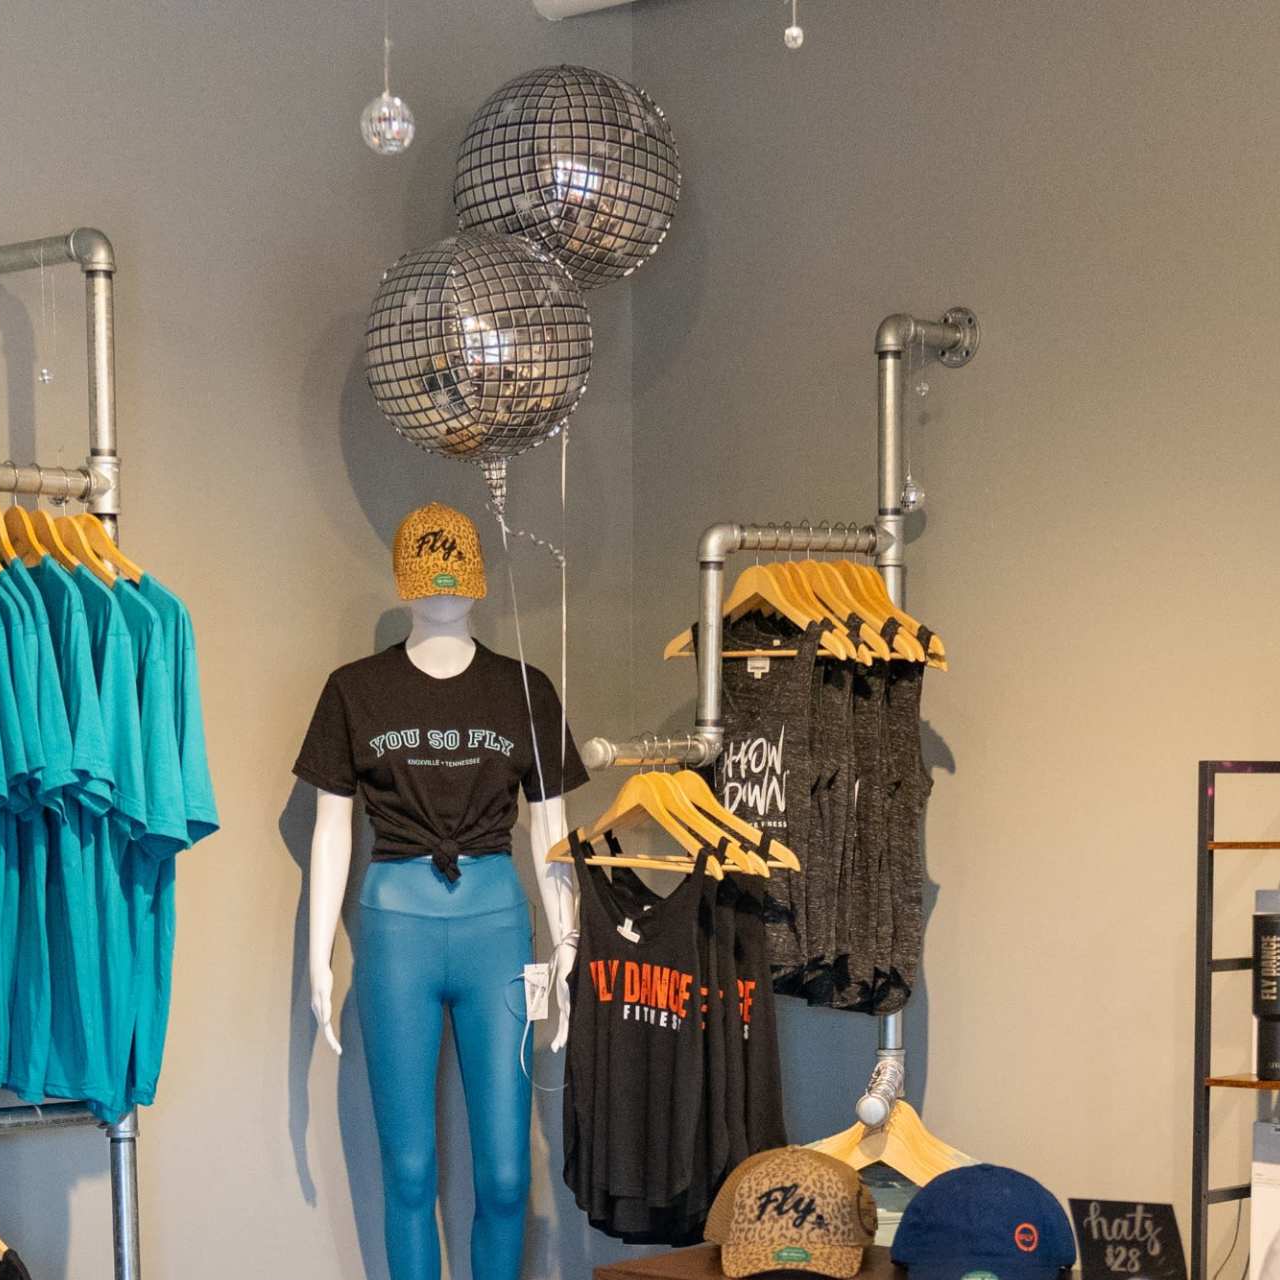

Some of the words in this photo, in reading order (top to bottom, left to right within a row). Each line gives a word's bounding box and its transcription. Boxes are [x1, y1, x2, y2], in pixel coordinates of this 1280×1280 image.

[369, 728, 420, 758] YOU
[427, 729, 461, 750] SO
[468, 729, 515, 757] FLY
[407, 757, 441, 767] KNOXVILLE
[444, 757, 481, 768] TENNESSEE
[1261, 935, 1278, 977] DANCE
[623, 960, 694, 1019] DANCE
[1261, 980, 1278, 1001] FLY
[757, 1183, 816, 1229] Fly
[1083, 1202, 1163, 1255] hats
[1105, 1246, 1141, 1272] $28
